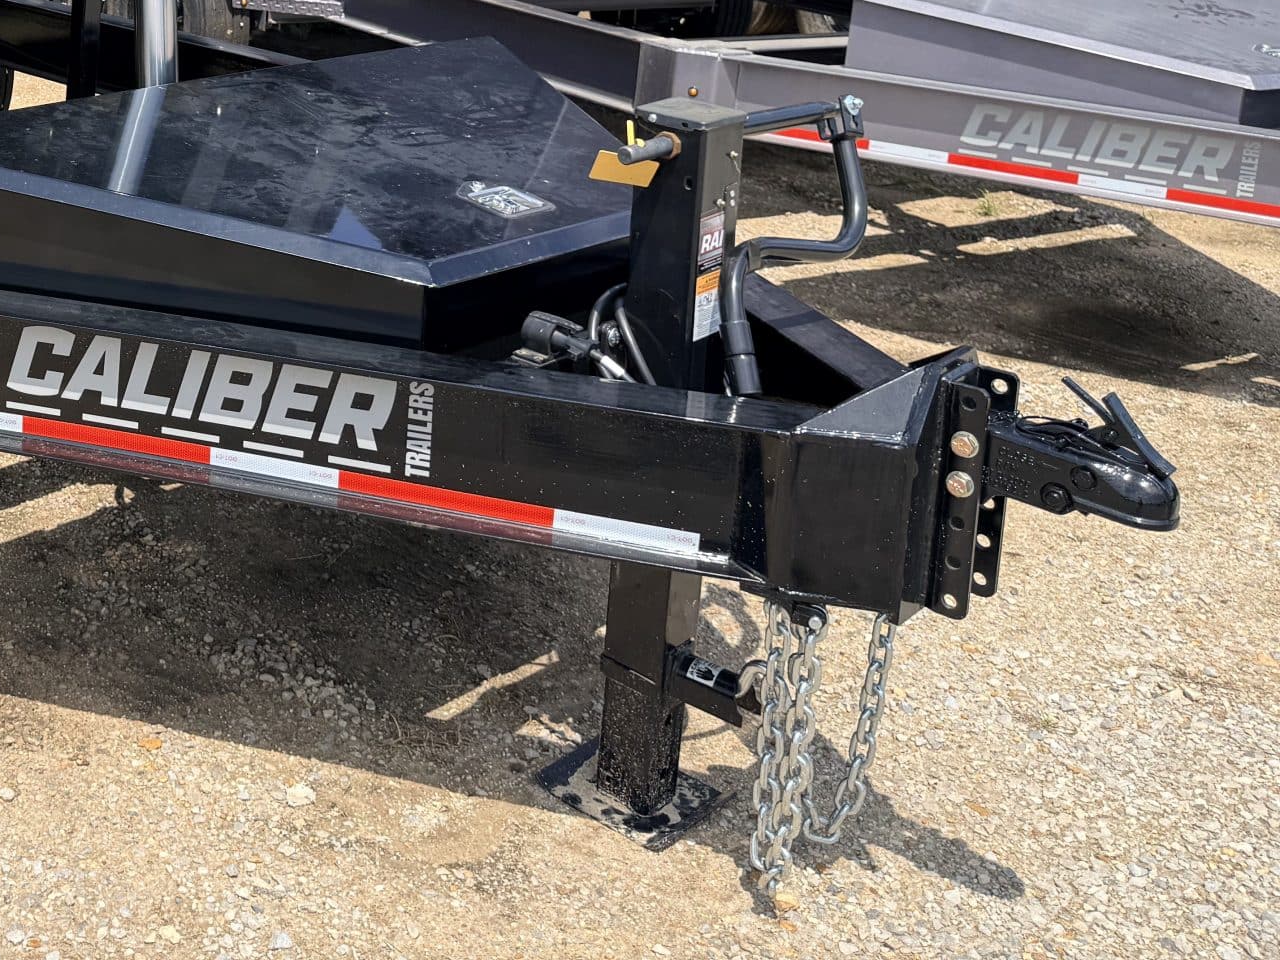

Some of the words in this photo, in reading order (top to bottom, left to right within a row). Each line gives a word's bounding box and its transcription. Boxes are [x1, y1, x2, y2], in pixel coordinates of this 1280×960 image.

[960, 104, 1235, 183] CALIBER
[1236, 139, 1263, 198] TRAILERS
[6, 325, 398, 452] CALIBER
[405, 380, 435, 478] TRAILERS
